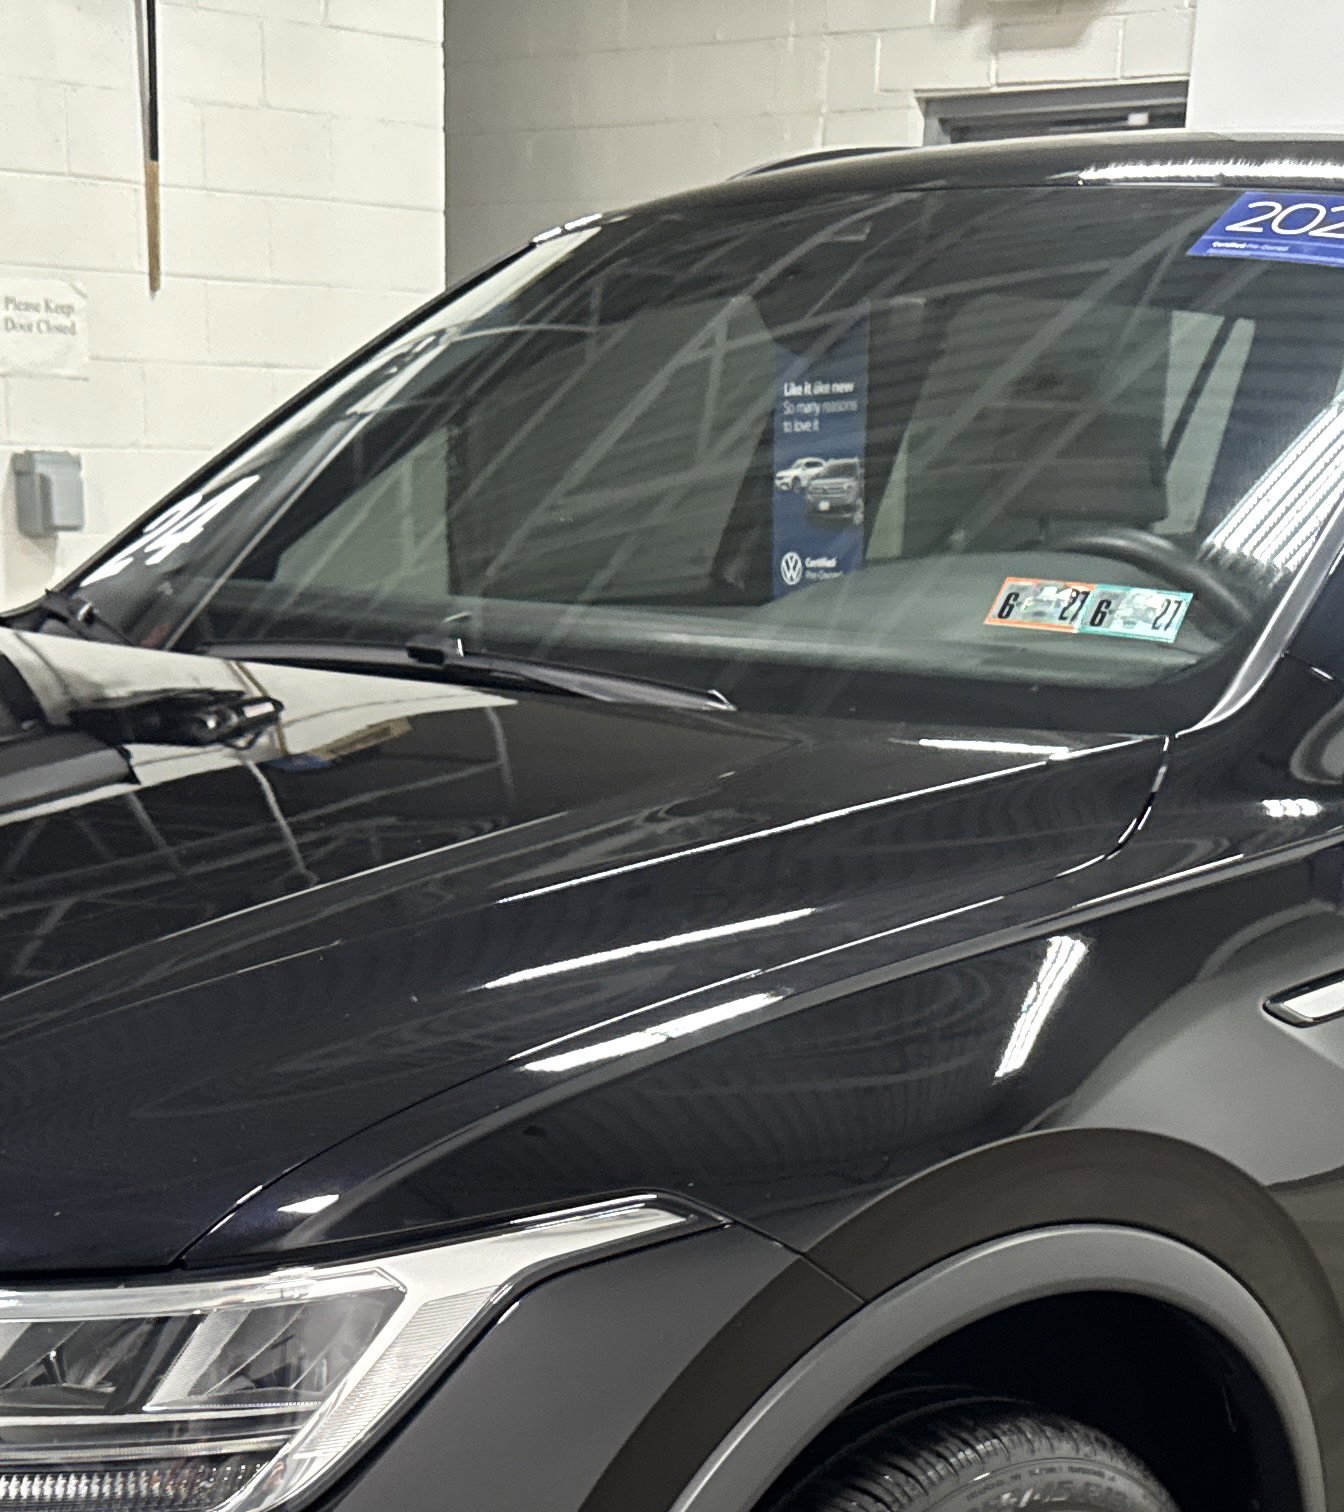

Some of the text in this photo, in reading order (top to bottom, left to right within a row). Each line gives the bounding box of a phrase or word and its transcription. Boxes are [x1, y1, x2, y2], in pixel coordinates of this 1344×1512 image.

[4, 296, 76, 318] Please Keep
[4, 317, 78, 337] Door Closed
[783, 382, 802, 397] Like
[803, 381, 812, 396] it
[831, 382, 855, 394] new
[783, 400, 795, 416] So
[796, 402, 820, 417] many
[783, 418, 820, 433] to love it
[805, 557, 837, 568] Certified
[997, 588, 1090, 624] 6 27
[1089, 598, 1183, 632] 6 27
